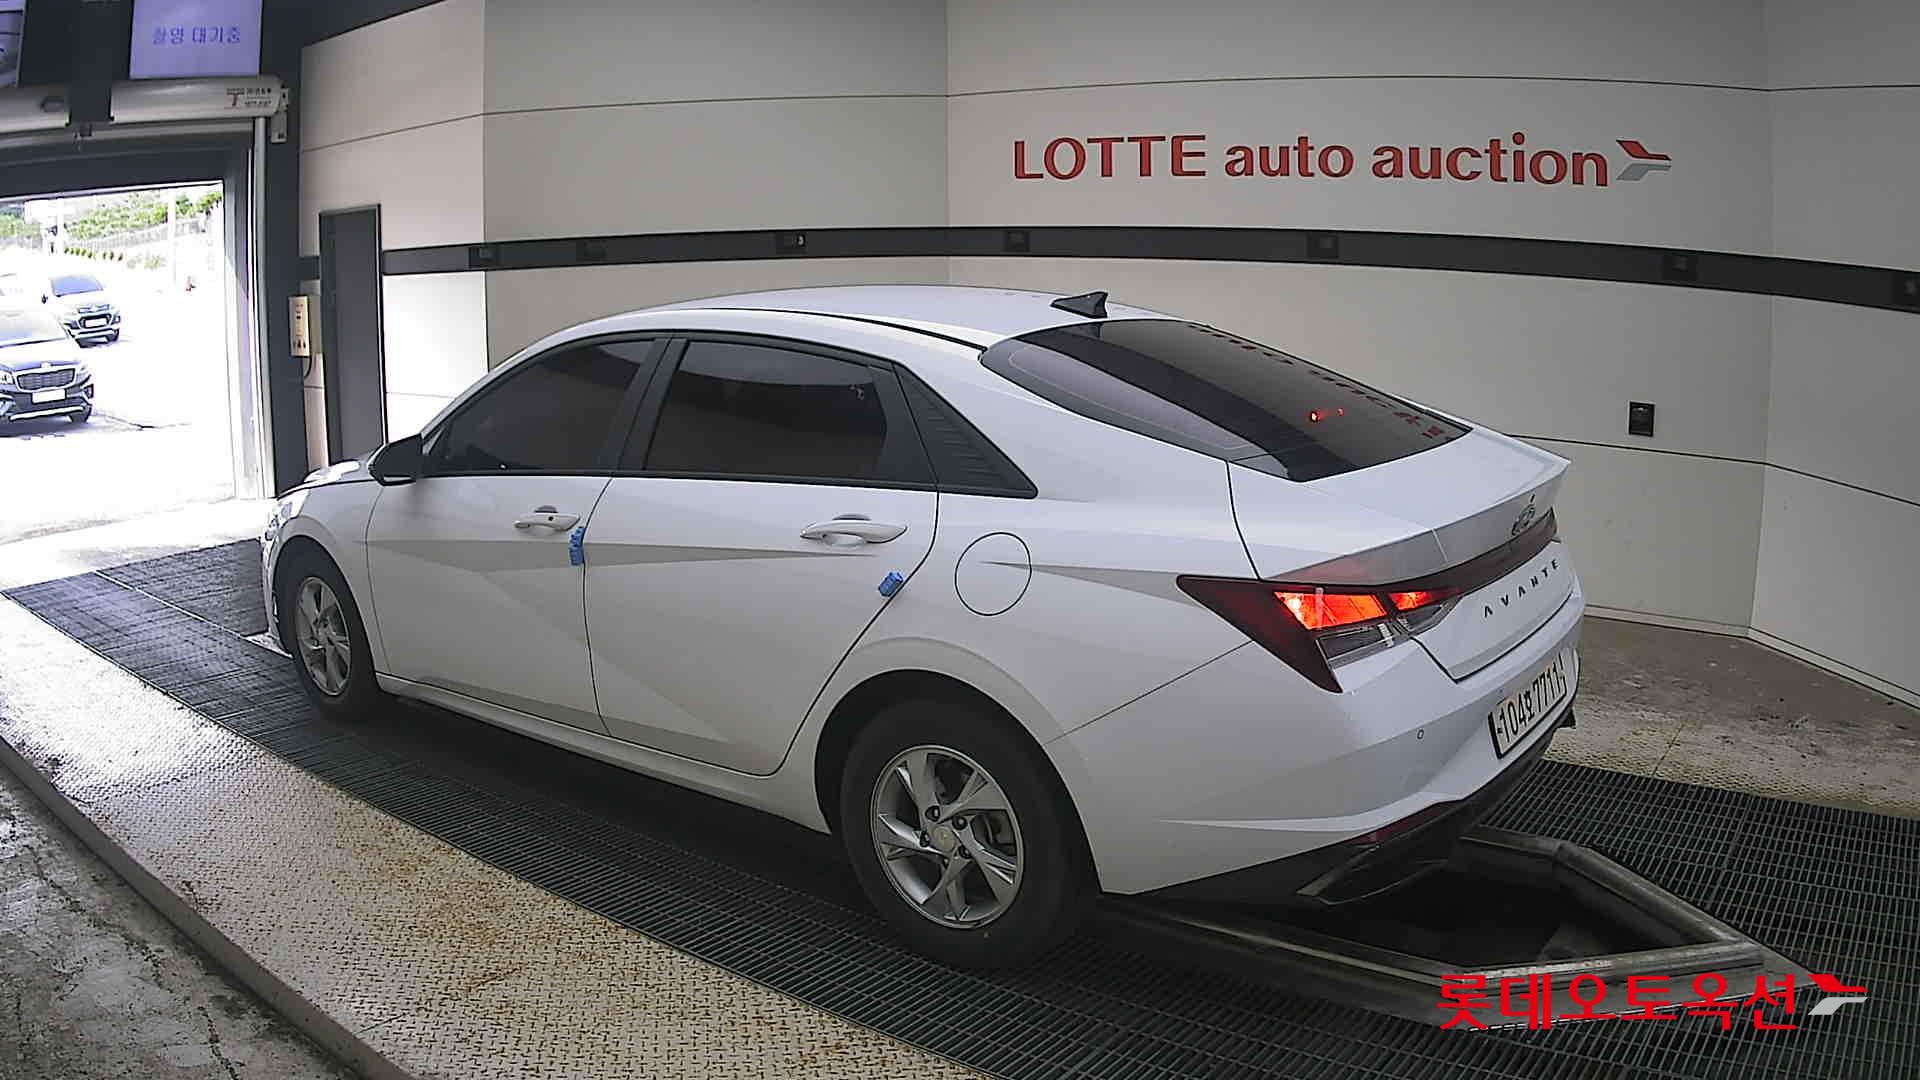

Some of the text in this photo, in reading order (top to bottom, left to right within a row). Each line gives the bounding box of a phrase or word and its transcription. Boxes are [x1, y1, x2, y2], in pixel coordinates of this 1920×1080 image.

[1013, 132, 1608, 187] LOTTE auto auction
[1484, 559, 1560, 618] AVANTE
